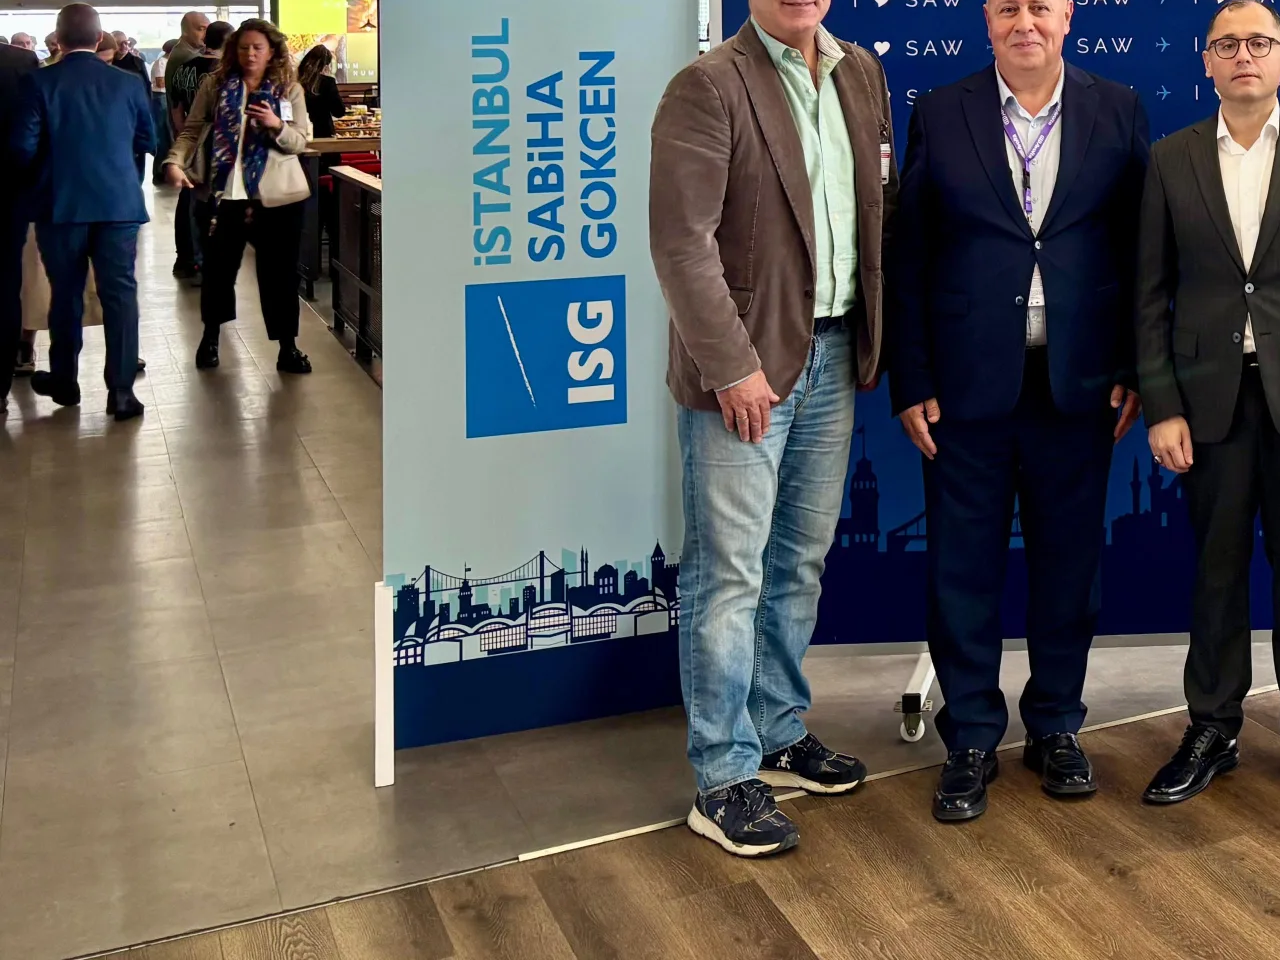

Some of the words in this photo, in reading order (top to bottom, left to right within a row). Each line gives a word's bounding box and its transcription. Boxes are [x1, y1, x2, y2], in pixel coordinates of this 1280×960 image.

[906, 39, 963, 56] SAW
[1076, 37, 1133, 54] SAW
[566, 299, 616, 405] ISG
